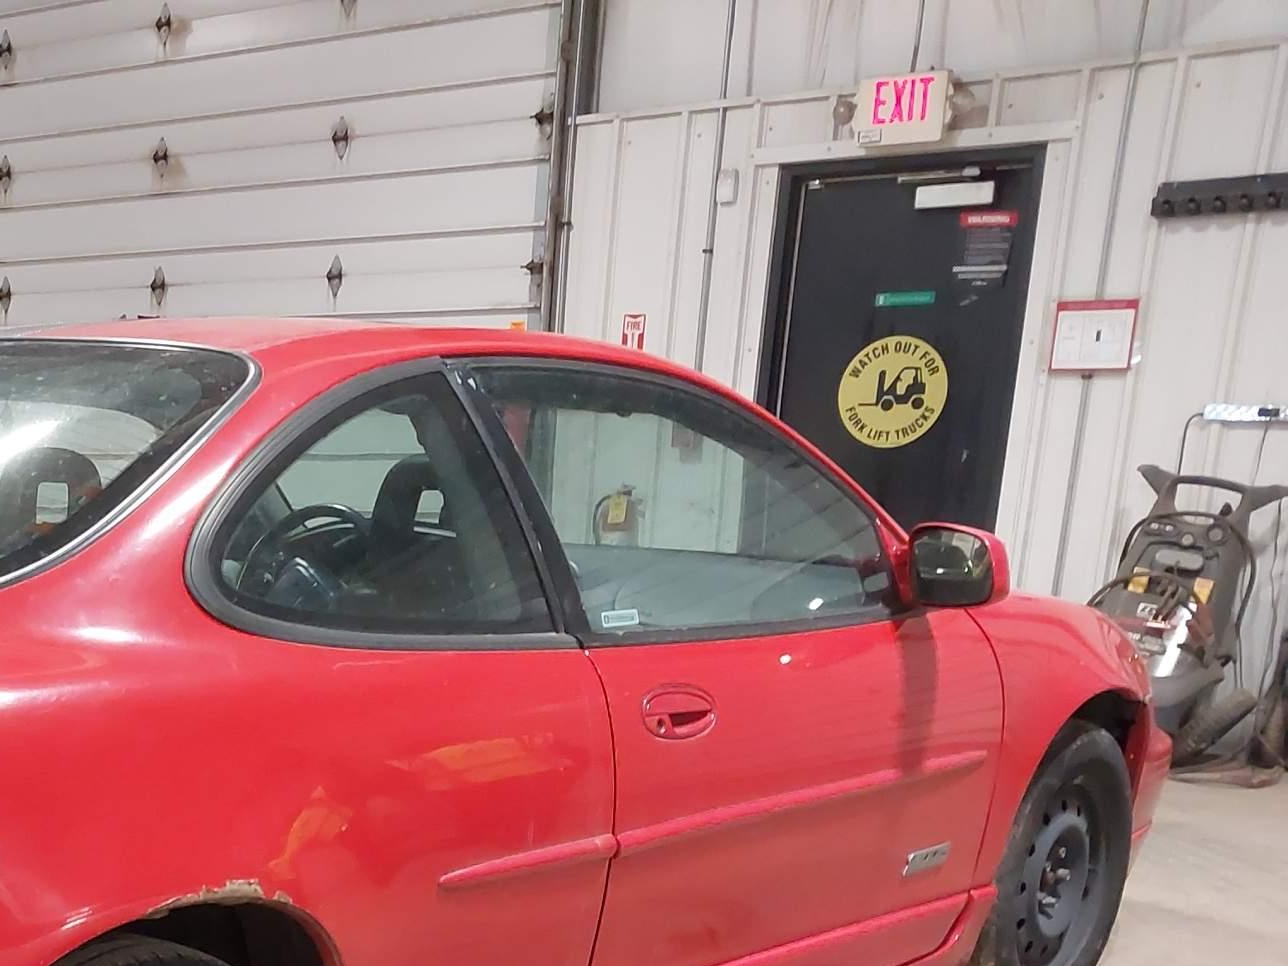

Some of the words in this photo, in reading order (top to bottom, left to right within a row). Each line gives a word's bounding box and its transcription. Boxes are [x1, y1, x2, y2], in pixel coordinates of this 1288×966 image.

[872, 76, 935, 125] EXIT
[626, 320, 642, 331] FIRE
[848, 342, 890, 379] WATCH
[894, 340, 921, 357] OUT
[918, 350, 940, 377] FOR
[845, 405, 868, 434] FORK
[866, 427, 891, 442] LIFT
[894, 405, 935, 441] TRUCKS
